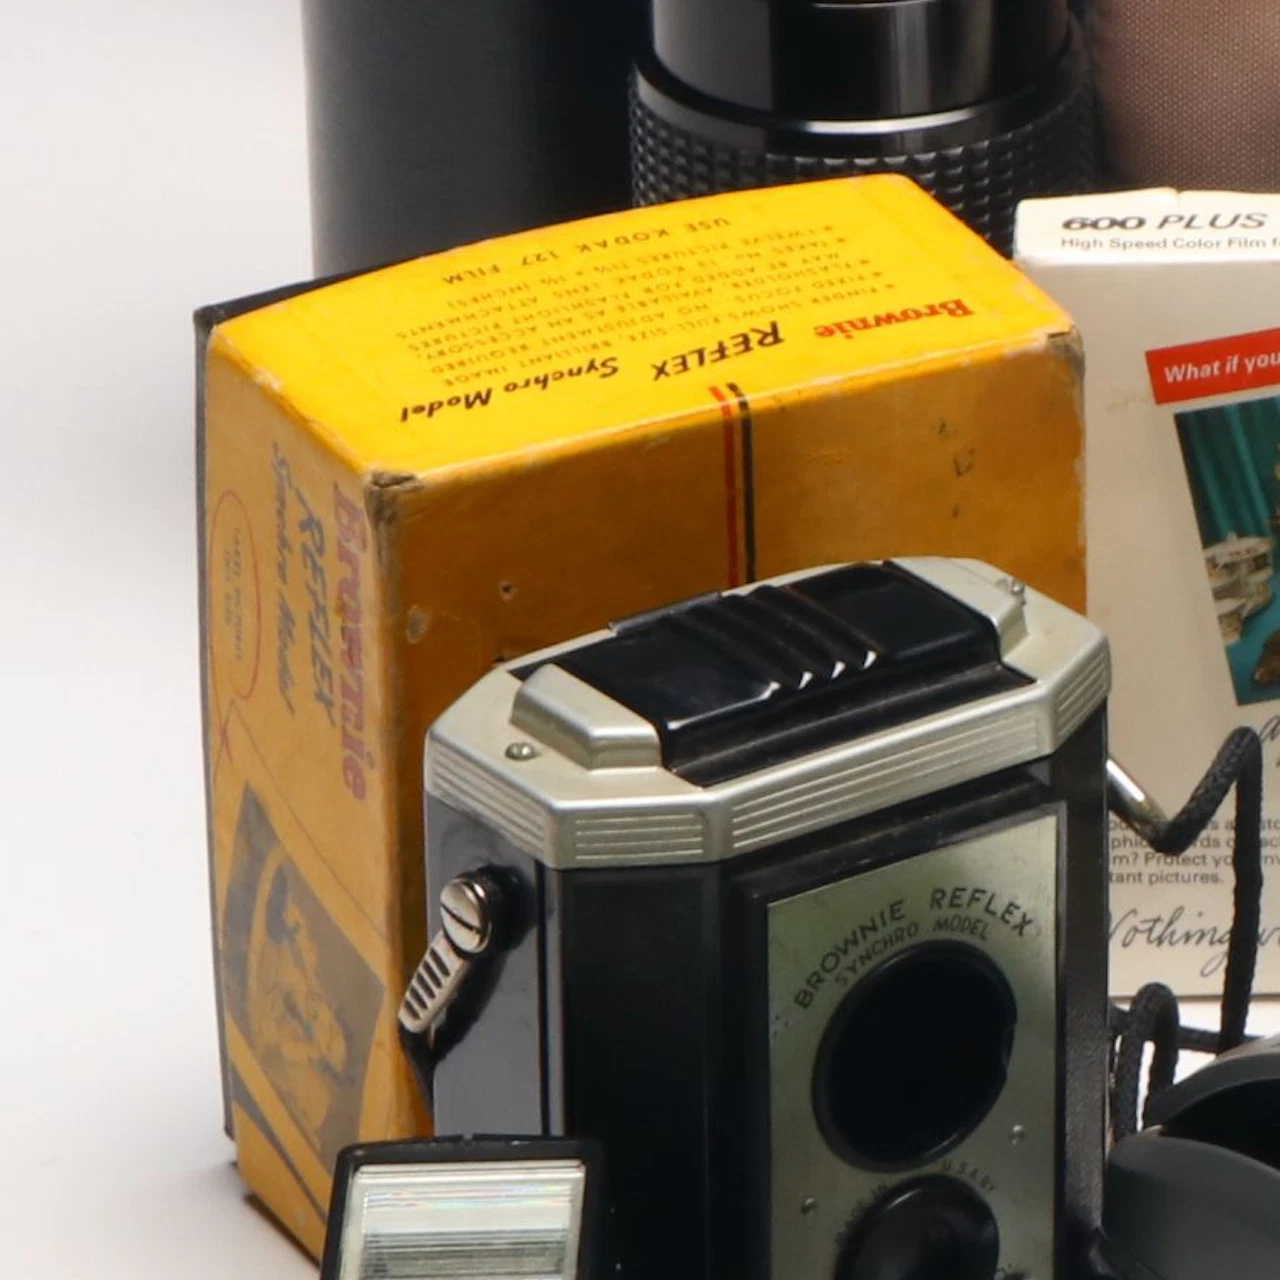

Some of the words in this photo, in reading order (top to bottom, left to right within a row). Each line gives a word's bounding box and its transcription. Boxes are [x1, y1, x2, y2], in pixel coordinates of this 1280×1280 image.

[683, 213, 730, 235] USE
[1061, 216, 1148, 231] 600
[1156, 211, 1269, 230] PLUS
[572, 225, 669, 256] KODAK
[1060, 236, 1103, 251] High
[1109, 237, 1168, 251] Speed
[1173, 236, 1222, 250] Color
[1227, 236, 1267, 249] Film
[440, 262, 501, 285] FILM
[812, 298, 976, 340] Brownie
[651, 320, 785, 381] REFLEX
[503, 356, 620, 393] Synchro
[1163, 360, 1221, 384] What
[1225, 354, 1239, 374] if
[399, 386, 493, 423] Model
[332, 480, 376, 802] Brownie
[1149, 870, 1225, 886] pictures.
[793, 898, 907, 1012] BROWNIE
[929, 886, 1035, 938] REFLEX
[834, 922, 920, 987] SYNCHRO
[932, 916, 989, 942] MODEL
